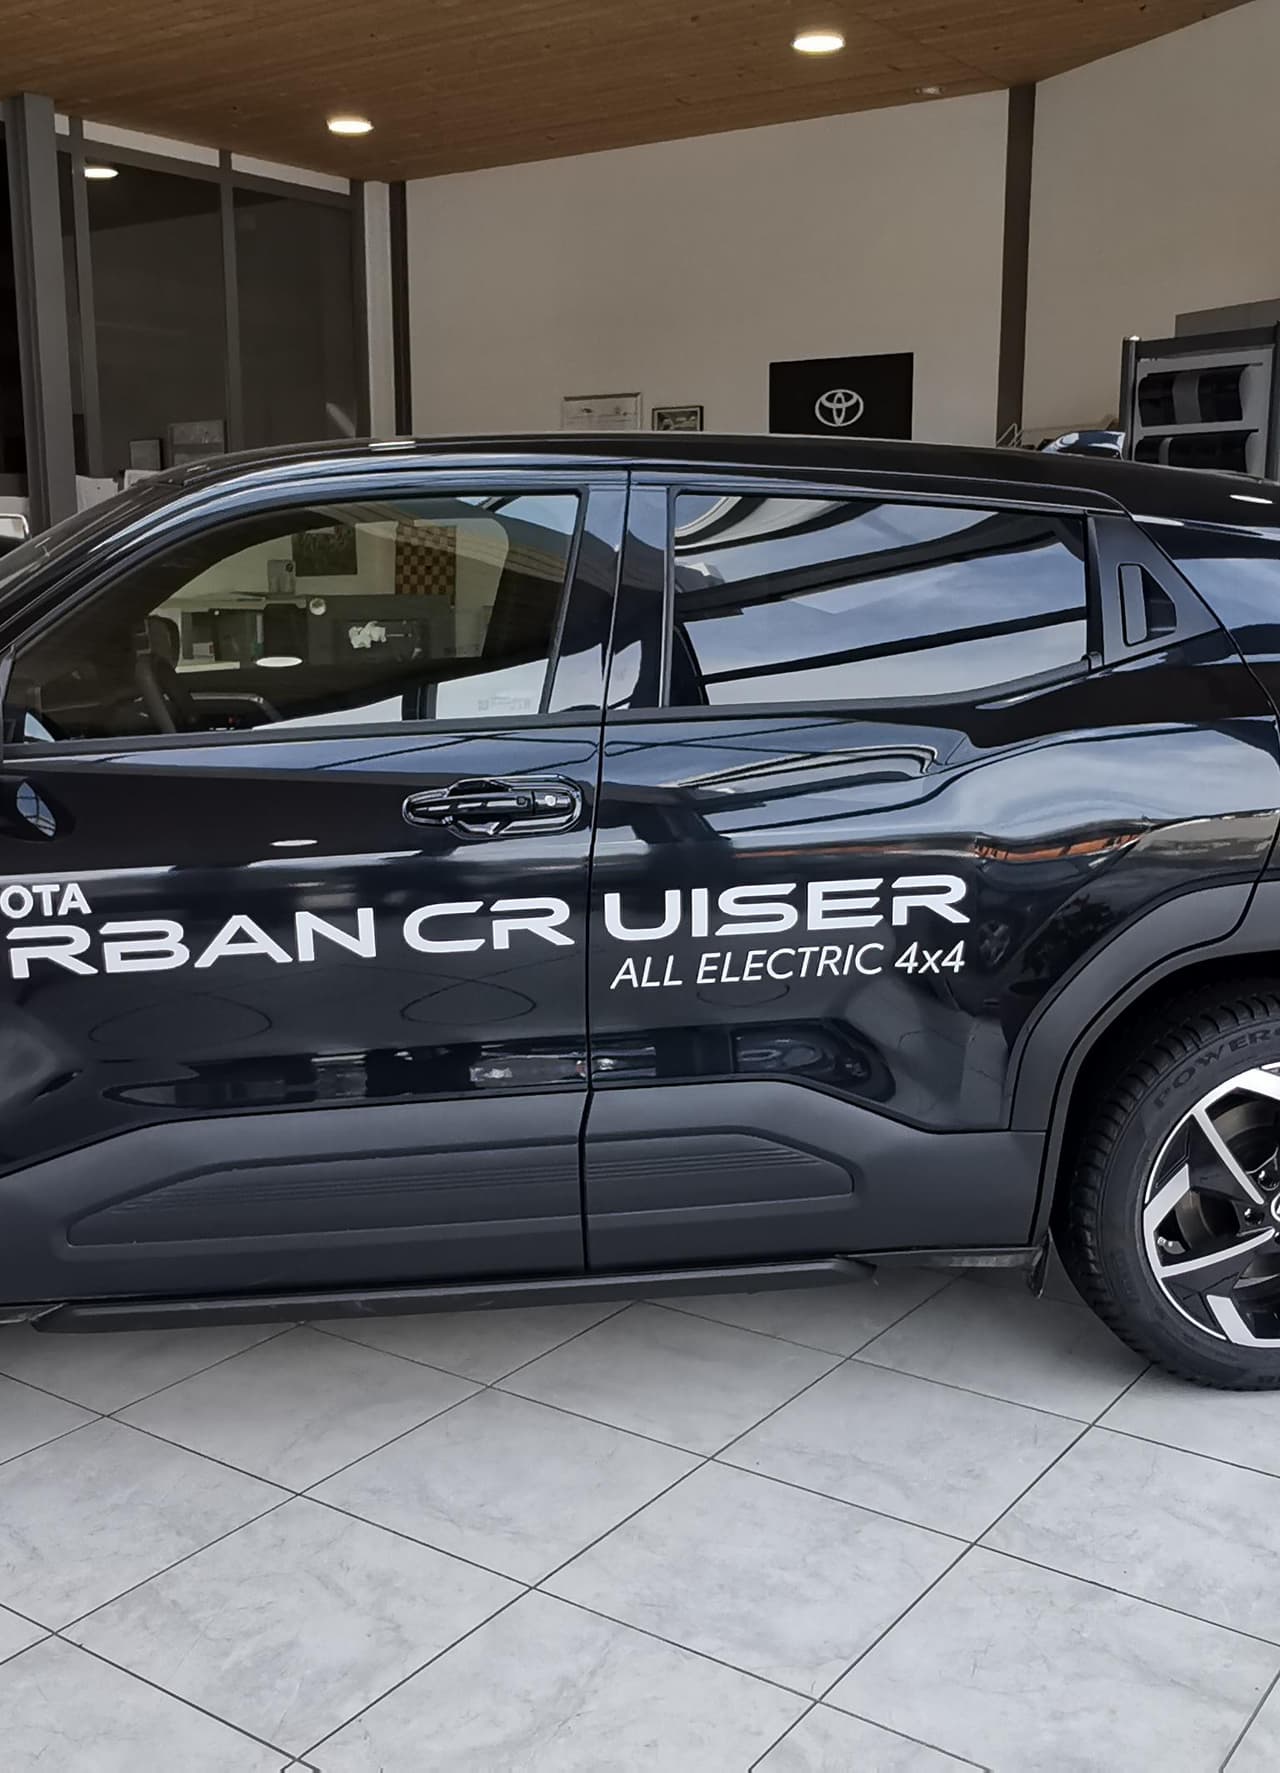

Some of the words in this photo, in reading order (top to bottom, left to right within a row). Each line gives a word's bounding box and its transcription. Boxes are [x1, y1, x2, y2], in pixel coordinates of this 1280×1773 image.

[609, 954, 684, 991] ALL
[696, 942, 885, 984] ELECTRIC
[894, 940, 966, 975] 4x4
